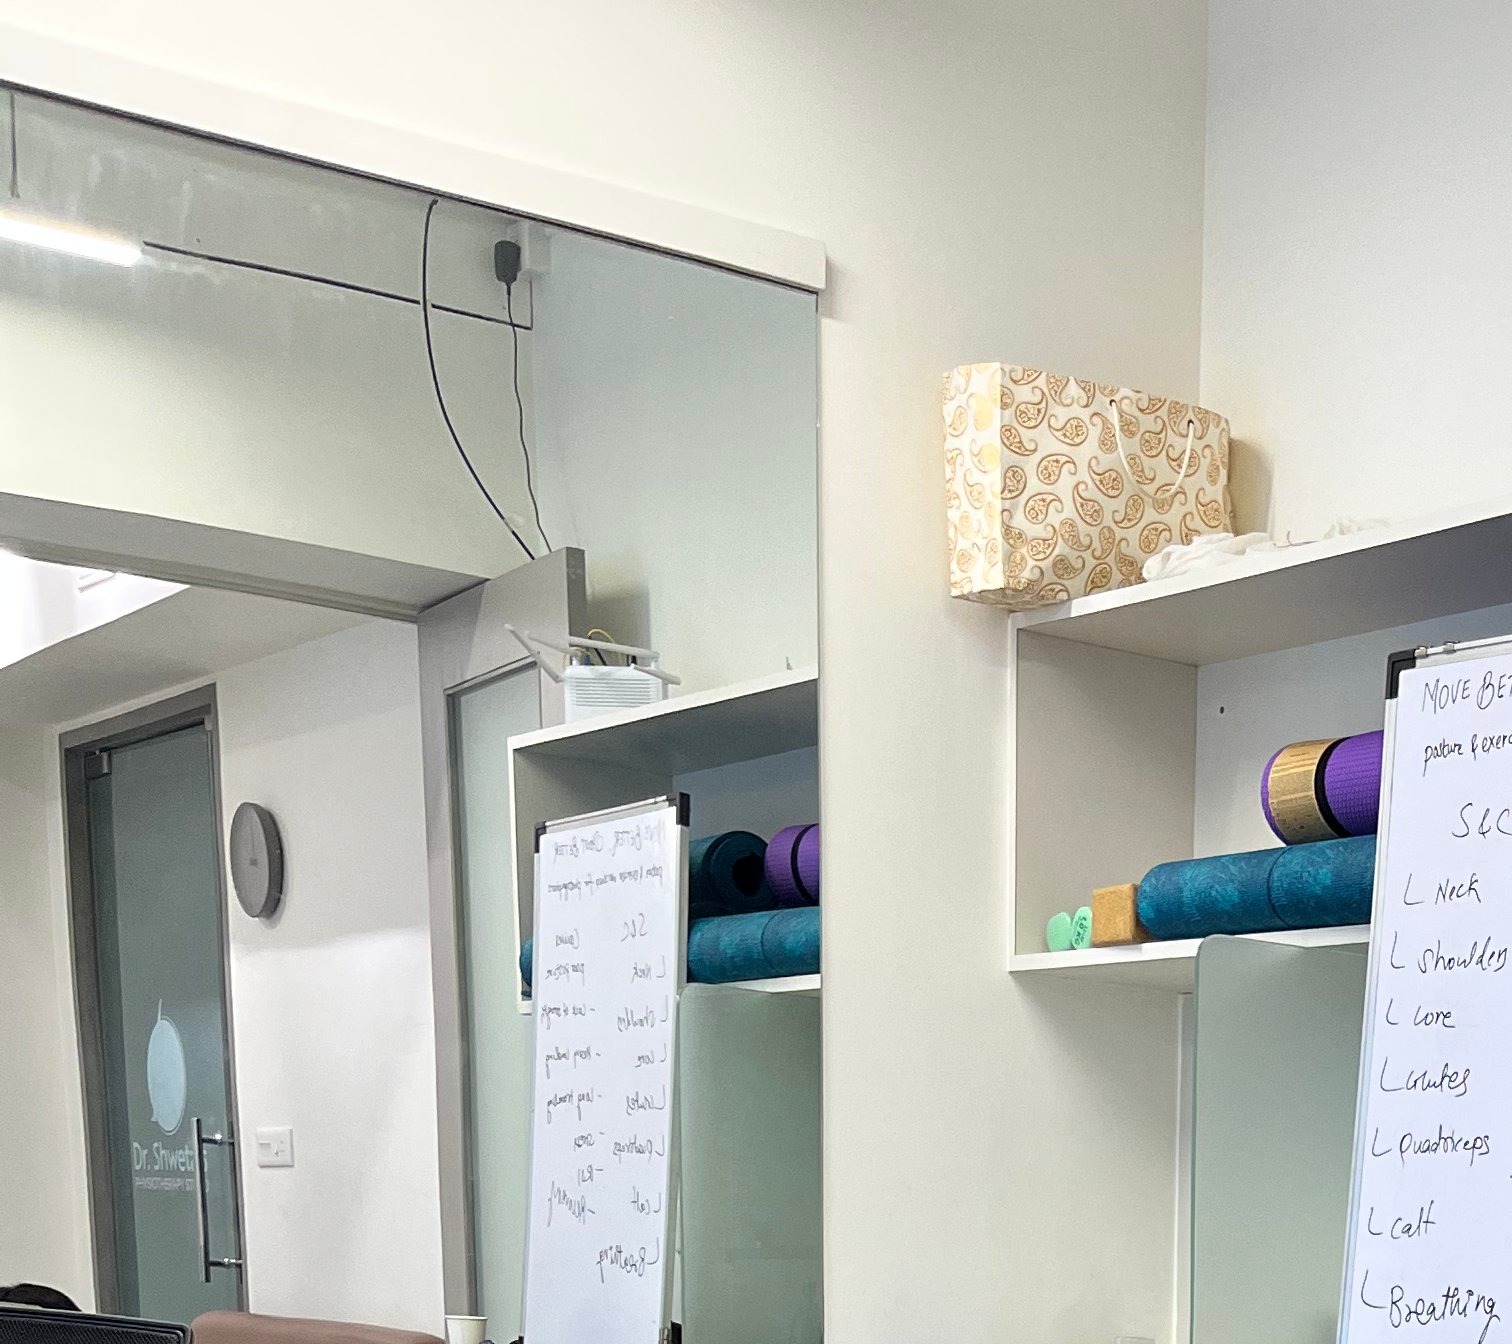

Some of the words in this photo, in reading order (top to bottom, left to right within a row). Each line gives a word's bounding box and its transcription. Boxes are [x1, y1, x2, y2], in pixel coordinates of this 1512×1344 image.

[1422, 677, 1471, 714] MOVE
[1435, 872, 1481, 905] Neck
[132, 1141, 151, 1171] Dr.
